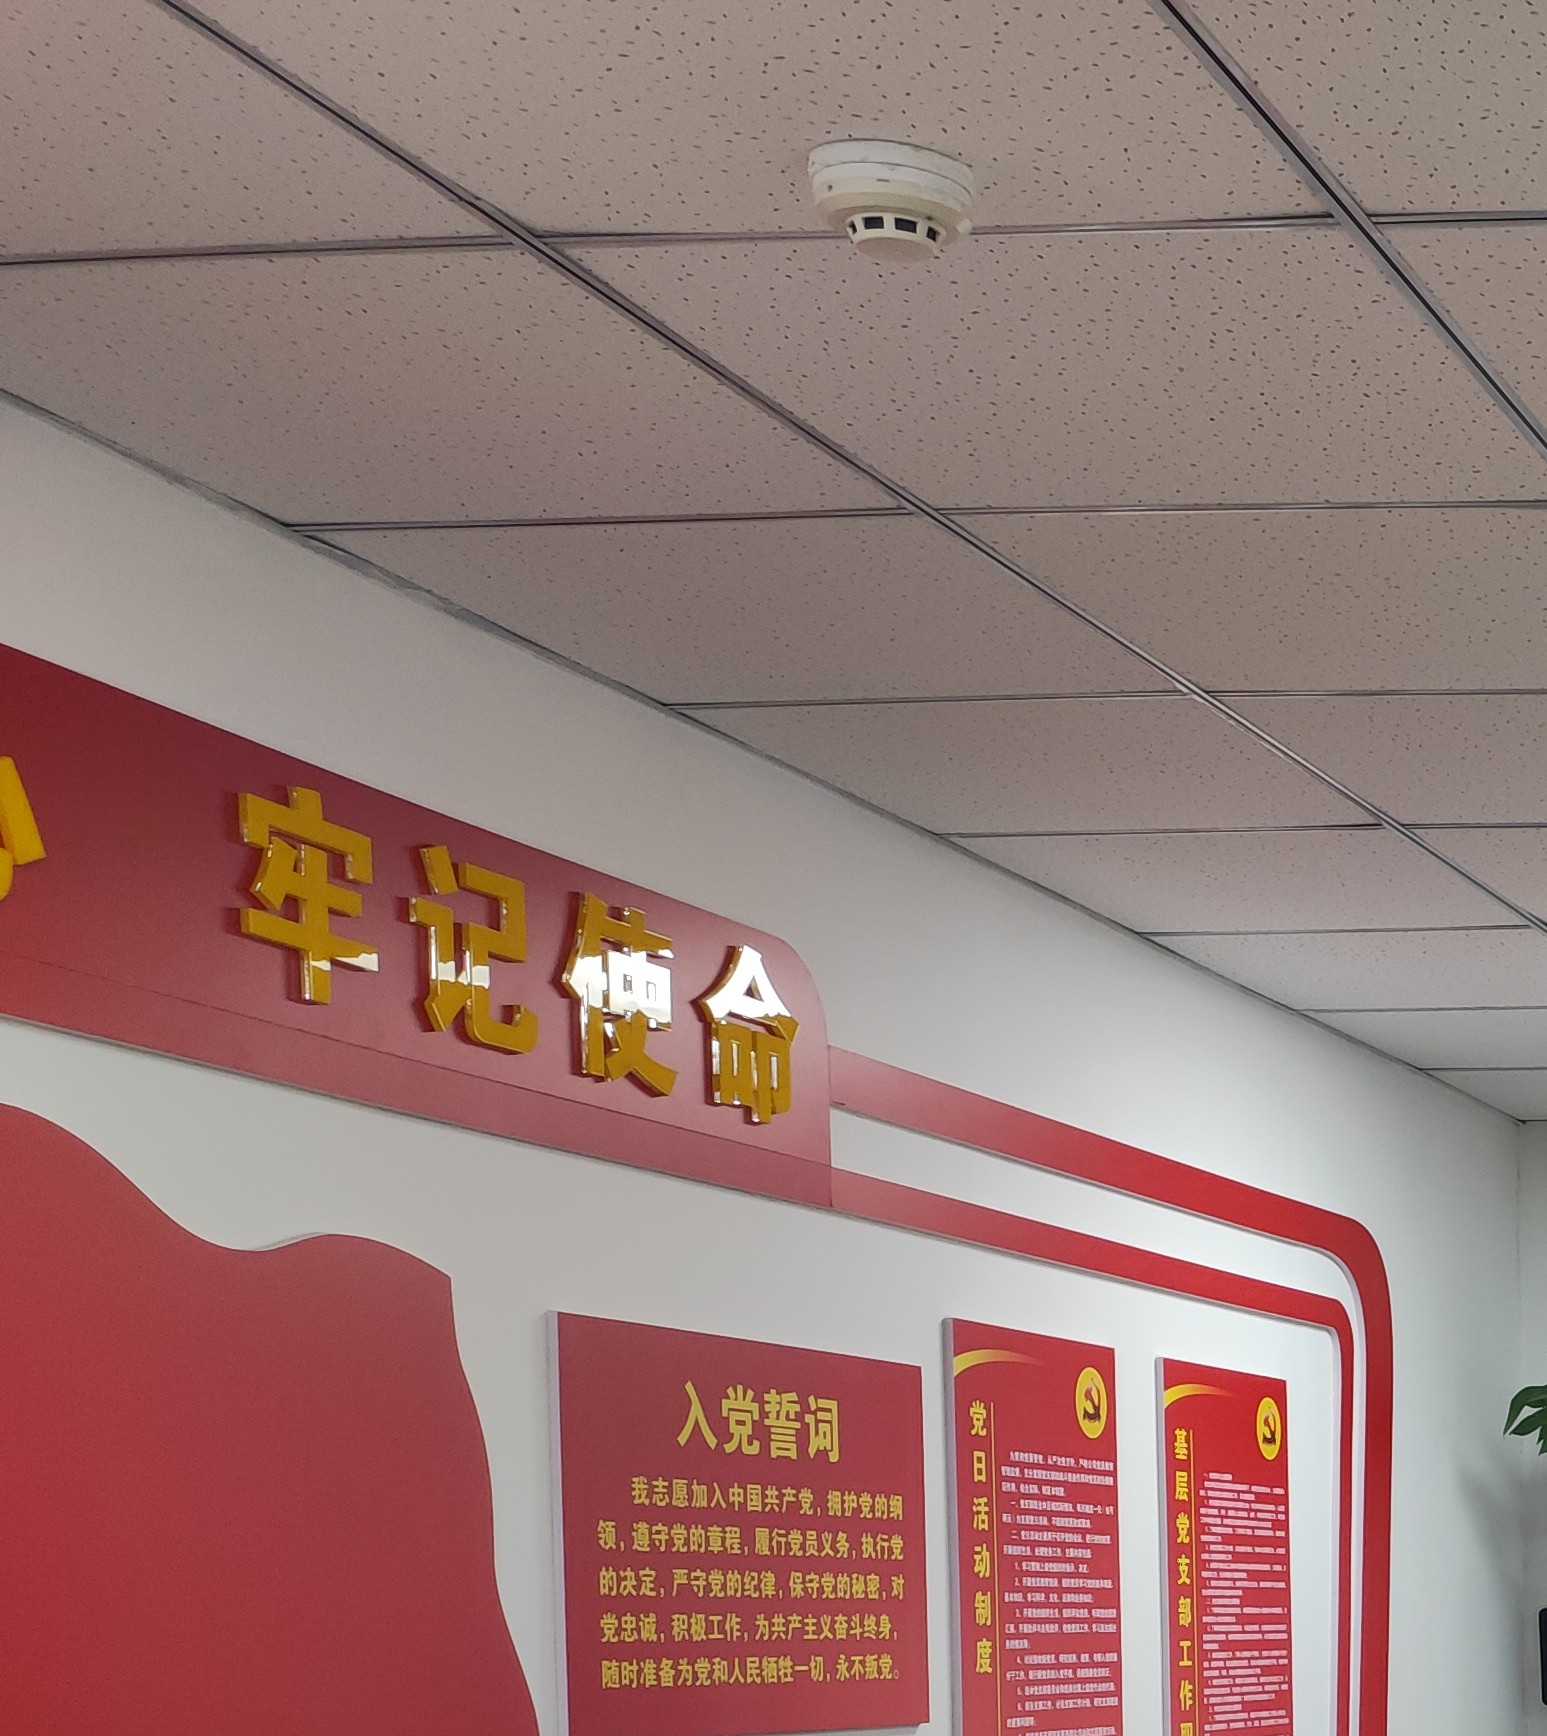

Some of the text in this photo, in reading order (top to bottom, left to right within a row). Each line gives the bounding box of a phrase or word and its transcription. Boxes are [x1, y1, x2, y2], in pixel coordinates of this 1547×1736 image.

[235, 785, 800, 1124] 牢记使命
[676, 1380, 840, 1463] 入党誓词
[631, 1475, 904, 1521] 我志愿加入中国共产党，拥护党的纲
[597, 1520, 904, 1561] 领，遵守党的章程，履行党员义务，执行党
[969, 1399, 993, 1674] 党日活动制度
[599, 1566, 905, 1600] 的决定，严守党的纪律，保守党的秘密，对
[601, 1653, 901, 1690] 随时准备为党和人民牺牲一切，永不叛党。
